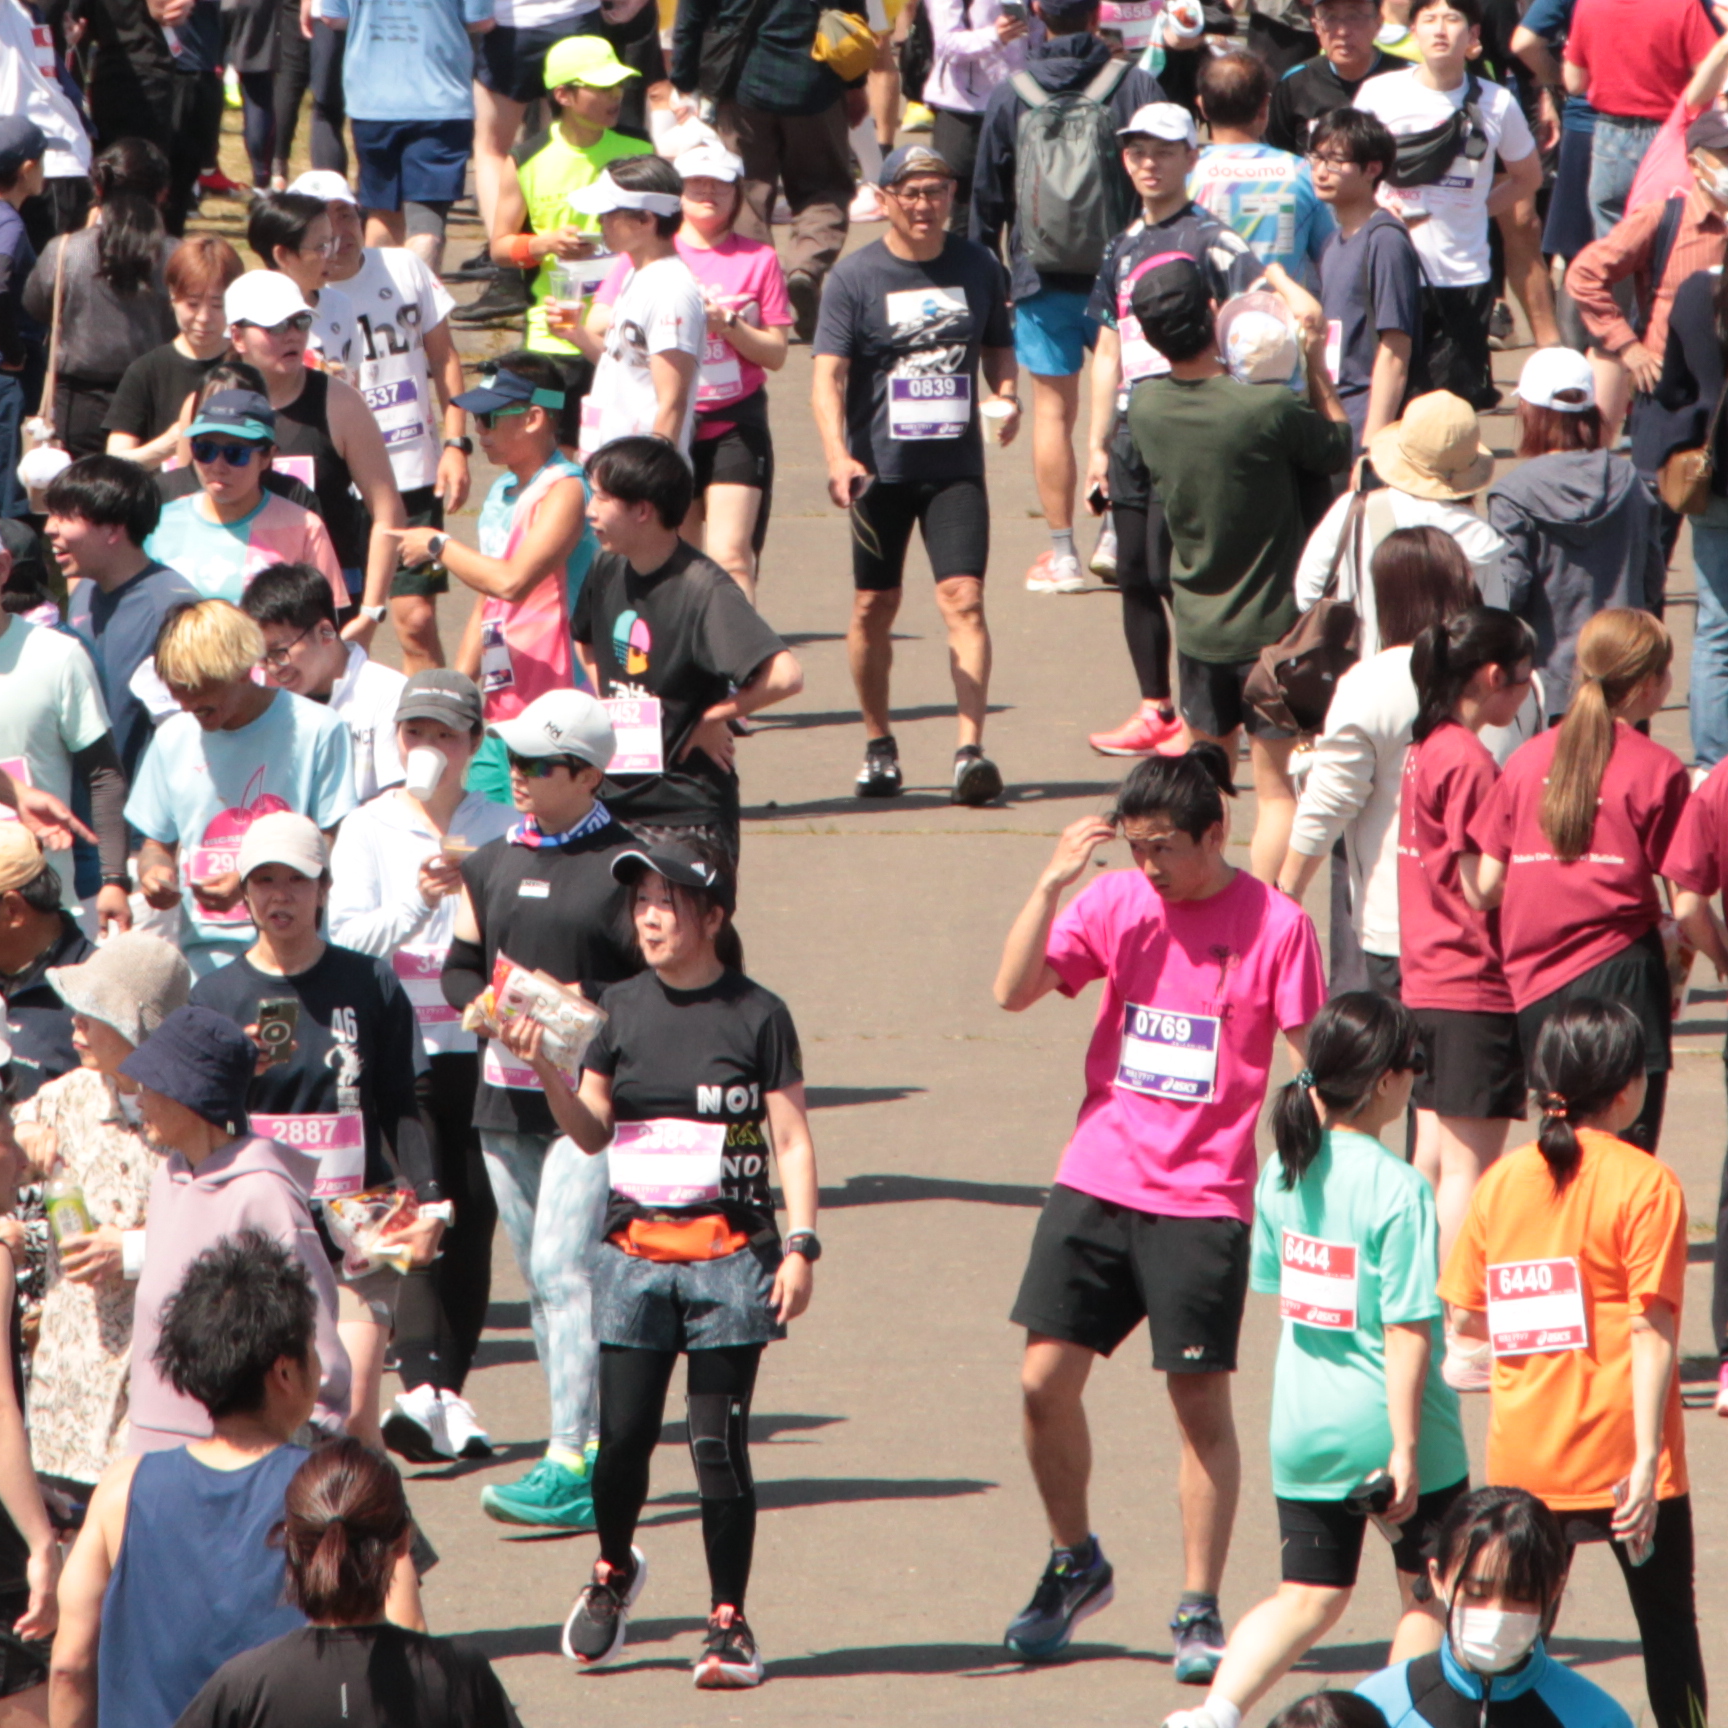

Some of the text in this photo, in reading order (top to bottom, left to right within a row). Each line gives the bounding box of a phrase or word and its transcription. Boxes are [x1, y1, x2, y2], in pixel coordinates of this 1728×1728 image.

[1113, 4, 1153, 20] 3656
[1208, 163, 1286, 179] docomo
[365, 383, 400, 409] 537
[909, 377, 957, 398] 0839
[332, 1008, 358, 1043] 46
[1136, 1009, 1192, 1042] 0769
[272, 1119, 339, 1145] 2887
[722, 1155, 762, 1179] NO
[1283, 1236, 1330, 1271] 6444
[1499, 1264, 1553, 1294] 6440
